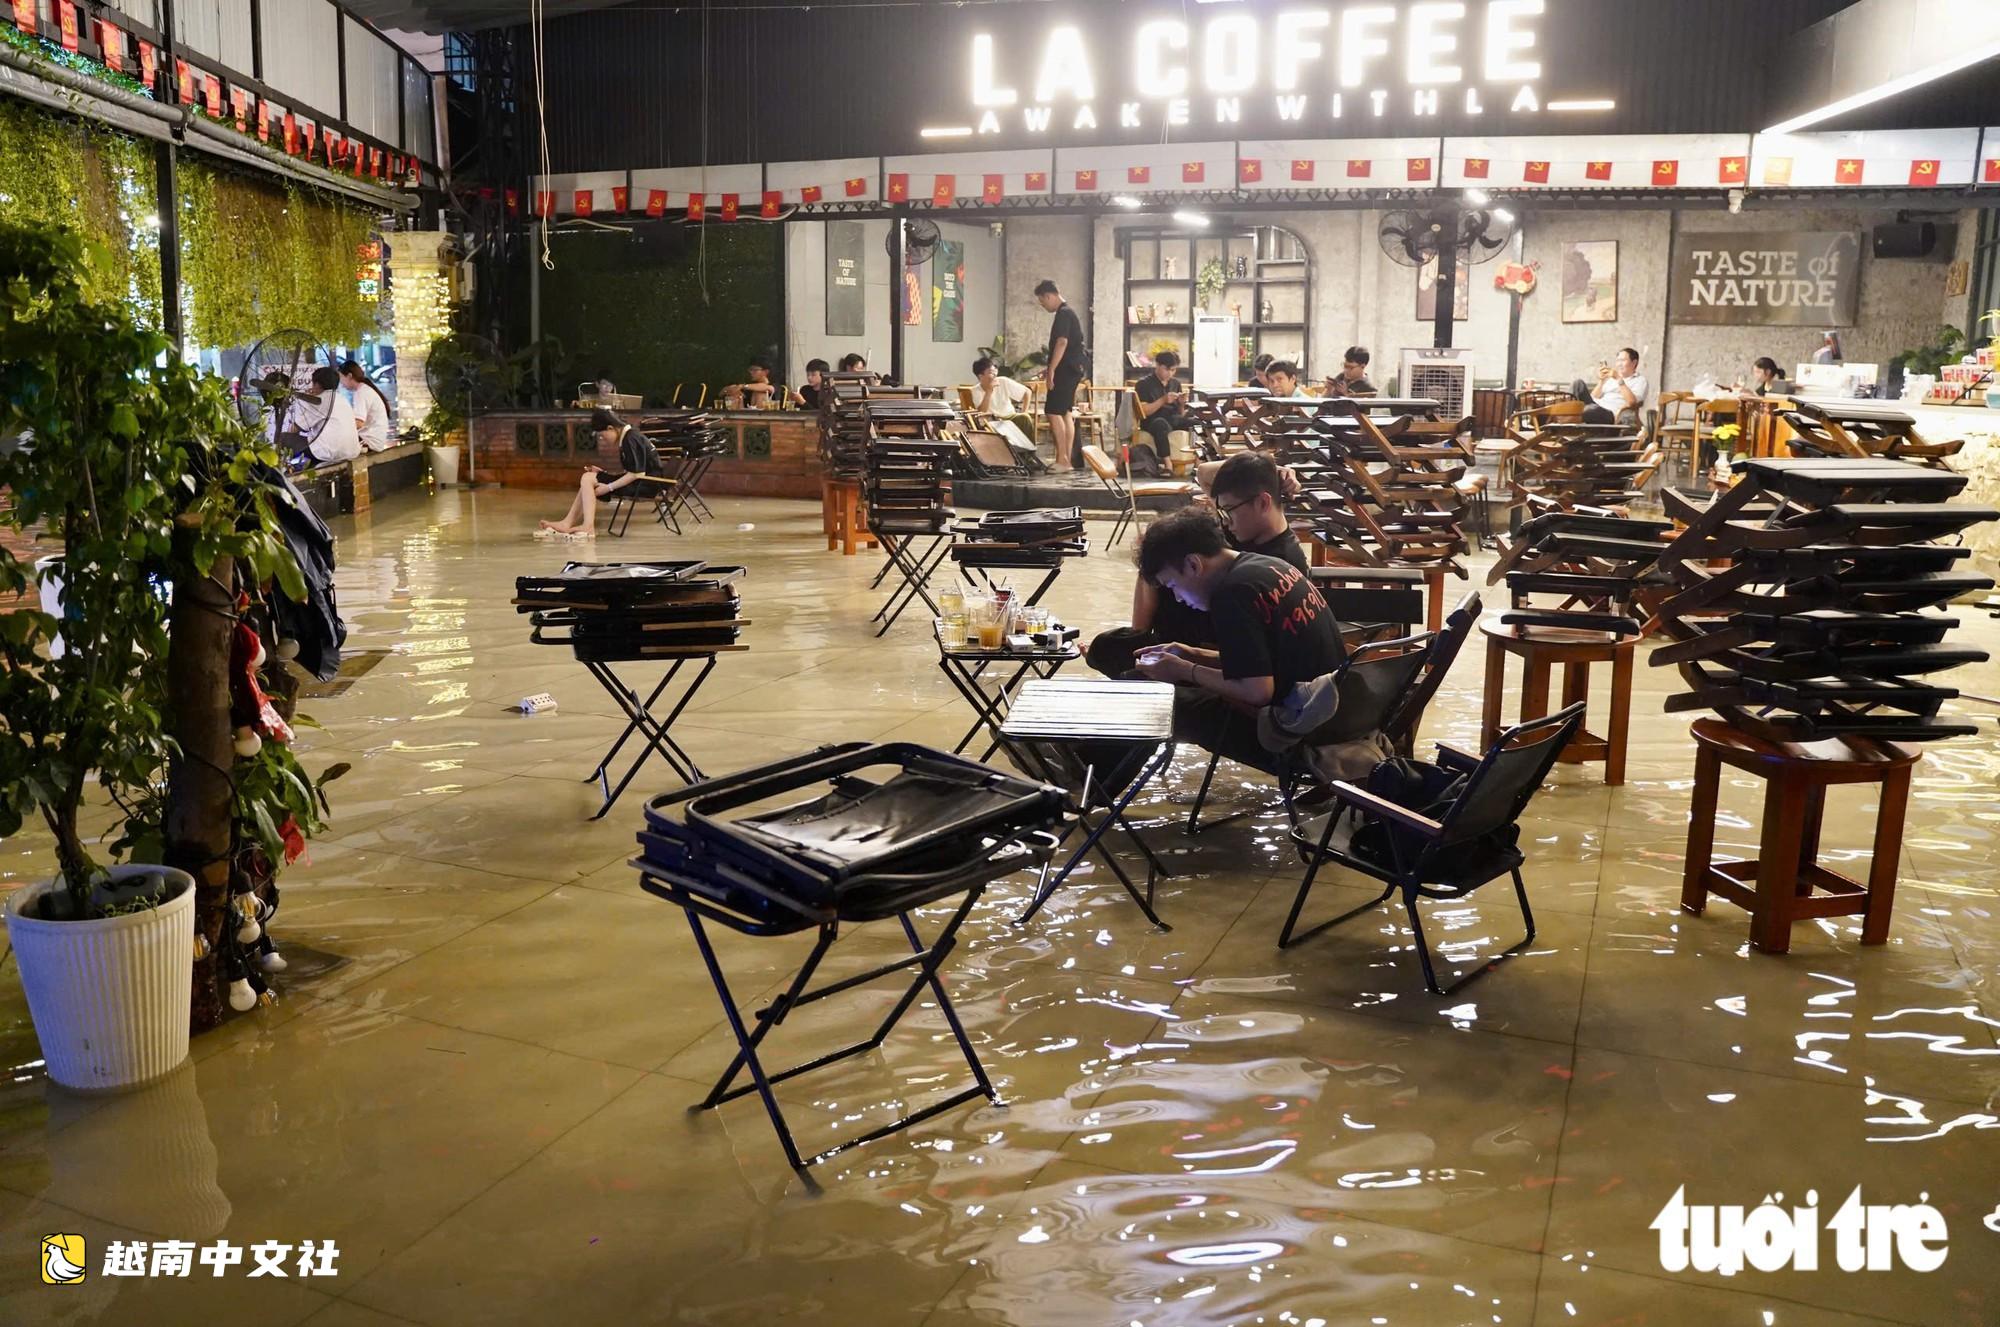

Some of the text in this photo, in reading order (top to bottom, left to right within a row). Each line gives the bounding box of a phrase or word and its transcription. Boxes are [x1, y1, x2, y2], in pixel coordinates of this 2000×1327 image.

[972, 0, 1545, 105] LA COFFEE
[977, 97, 1240, 133] AWAKEN
[1692, 250, 1839, 276] TASTE of
[1689, 279, 1836, 307] NATURE
